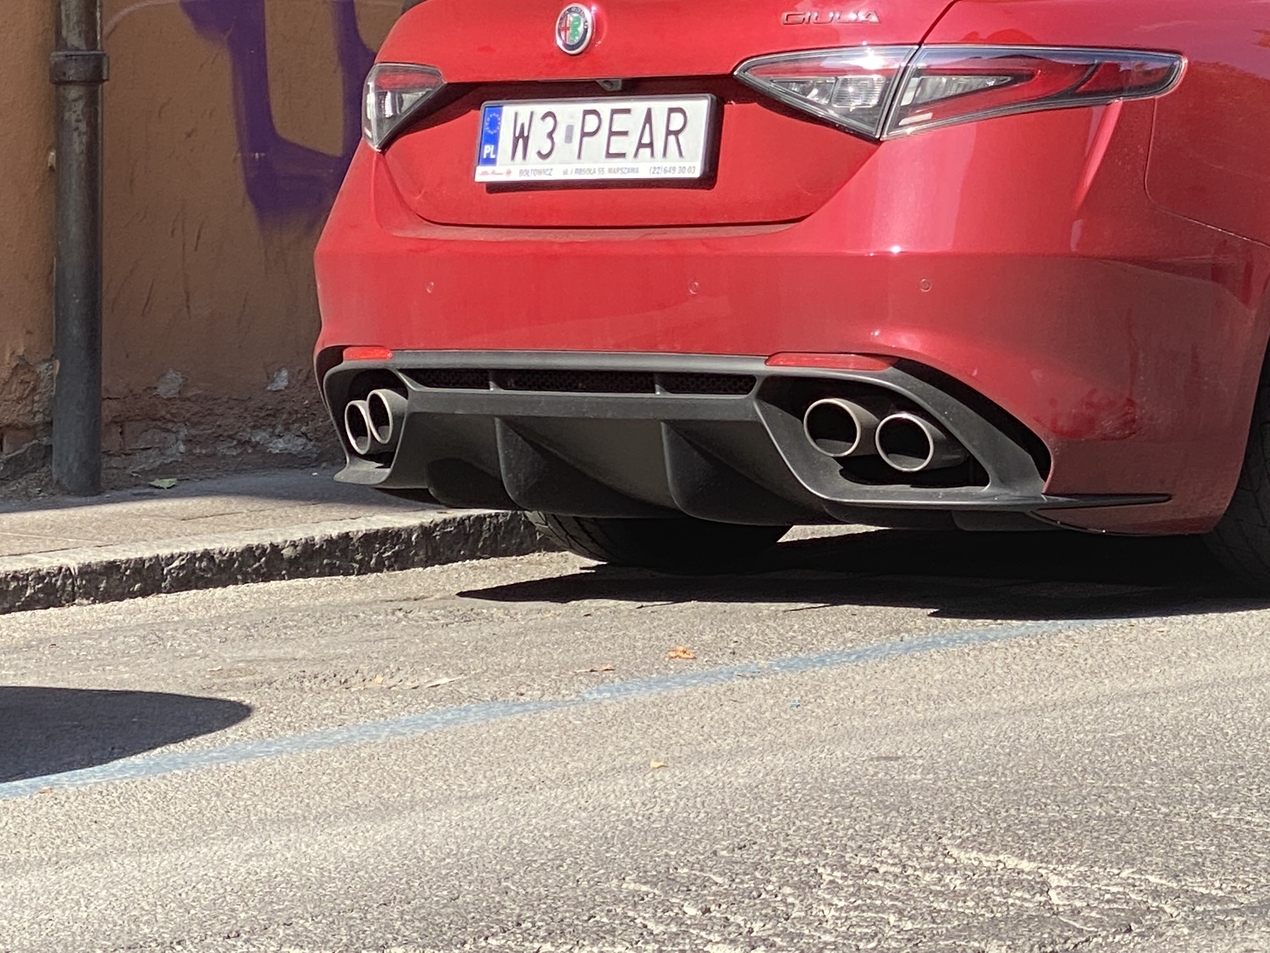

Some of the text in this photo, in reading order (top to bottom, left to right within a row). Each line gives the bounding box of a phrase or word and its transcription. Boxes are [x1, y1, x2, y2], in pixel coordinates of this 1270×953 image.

[782, 11, 881, 25] GIULIA
[511, 107, 688, 161] W3 PEAR
[483, 144, 496, 160] PL
